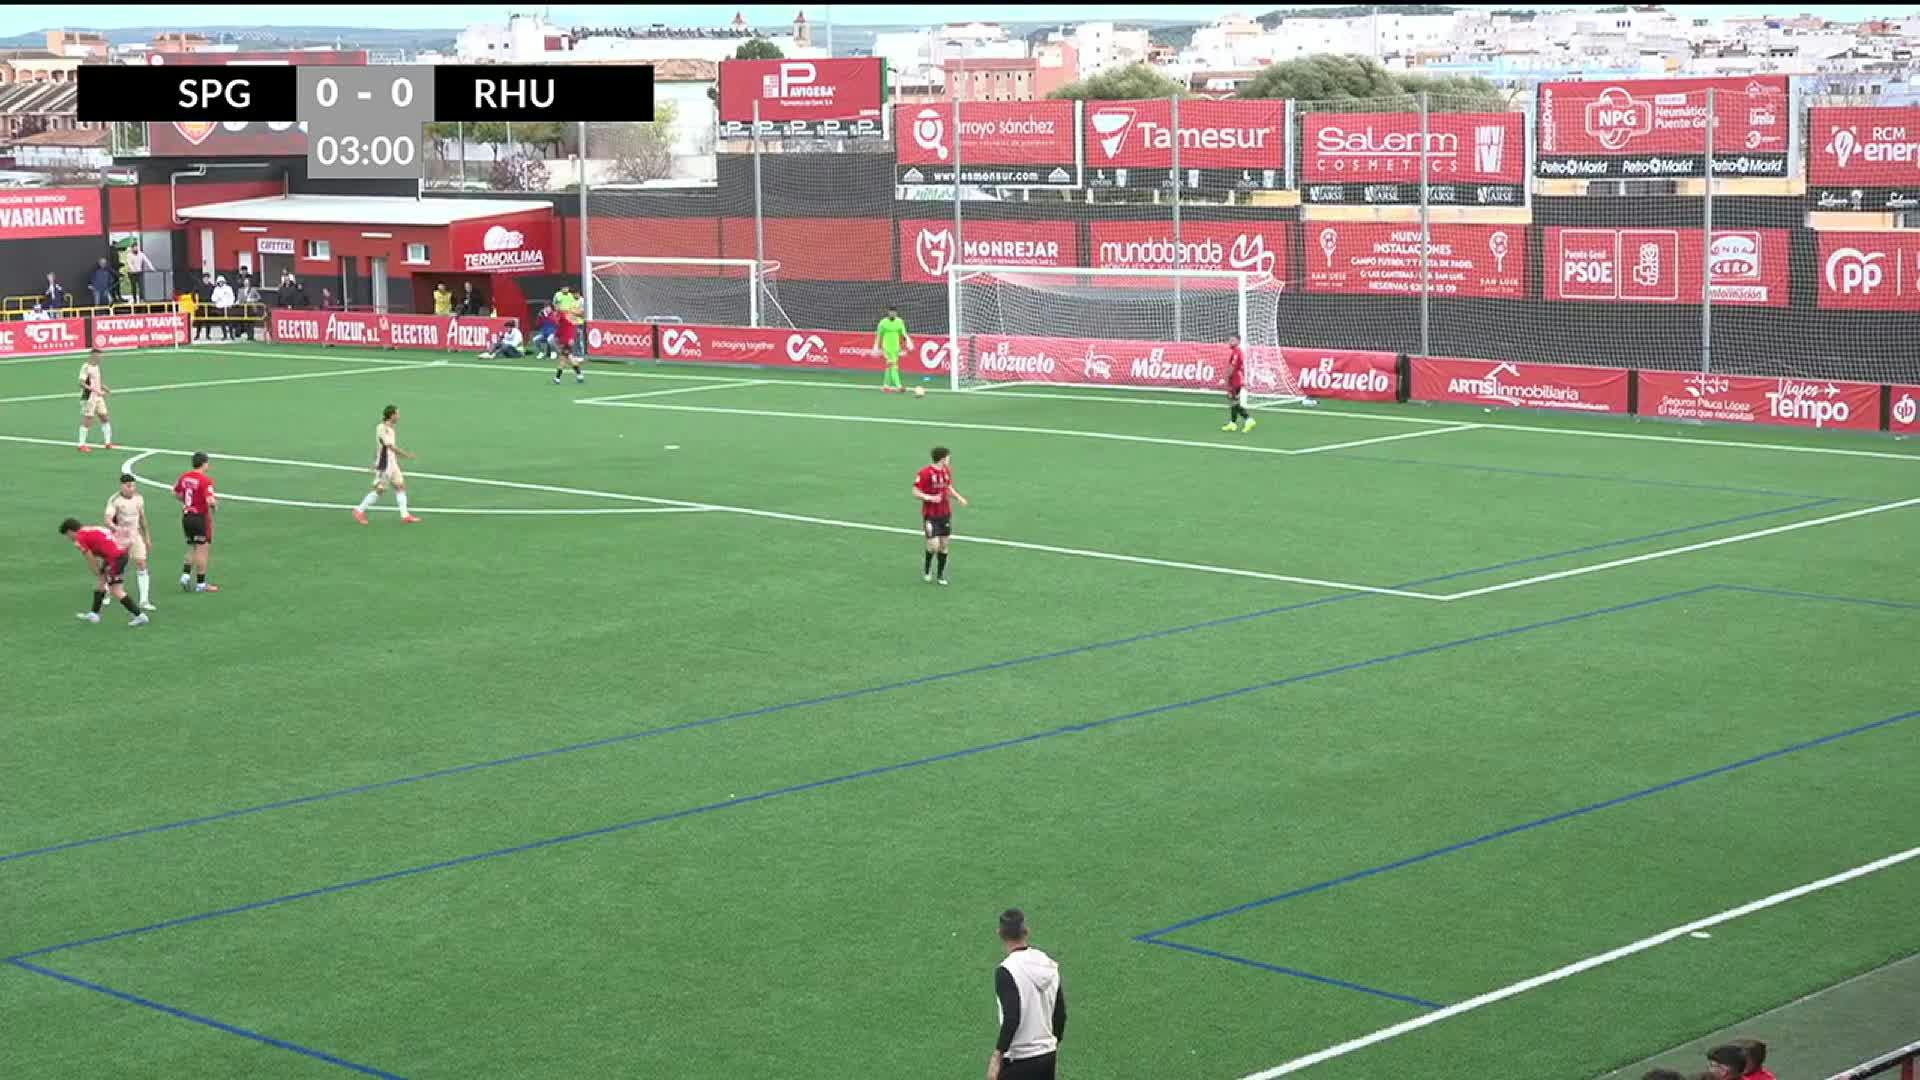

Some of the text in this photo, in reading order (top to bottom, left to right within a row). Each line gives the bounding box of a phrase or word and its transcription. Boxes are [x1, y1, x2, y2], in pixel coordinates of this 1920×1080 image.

[1000, 115, 1055, 135] sánchez
[1599, 110, 1638, 126] NPG
[1136, 121, 1270, 149] Tamesur
[1317, 126, 1458, 151] Salerm
[1872, 126, 1906, 141] RCM
[0, 206, 85, 227] VARIANTE
[463, 249, 544, 267] TERMOKLIMA
[964, 241, 1059, 258] MONREJAR
[1564, 261, 1613, 284] PSOE
[147, 316, 184, 328] TRAVEL
[278, 319, 319, 339] ELECTRO
[33, 323, 73, 344] GTL
[391, 322, 438, 345] ELECTRO
[979, 350, 1055, 374] Mozuelo
[1130, 357, 1215, 381] Mozuelo
[1319, 358, 1334, 374] El
[1298, 367, 1389, 393] Mozuelo
[1448, 378, 1579, 401] ARTIS inmobiliaria
[1778, 378, 1822, 398] Viajes
[1765, 392, 1849, 428] Tempo
